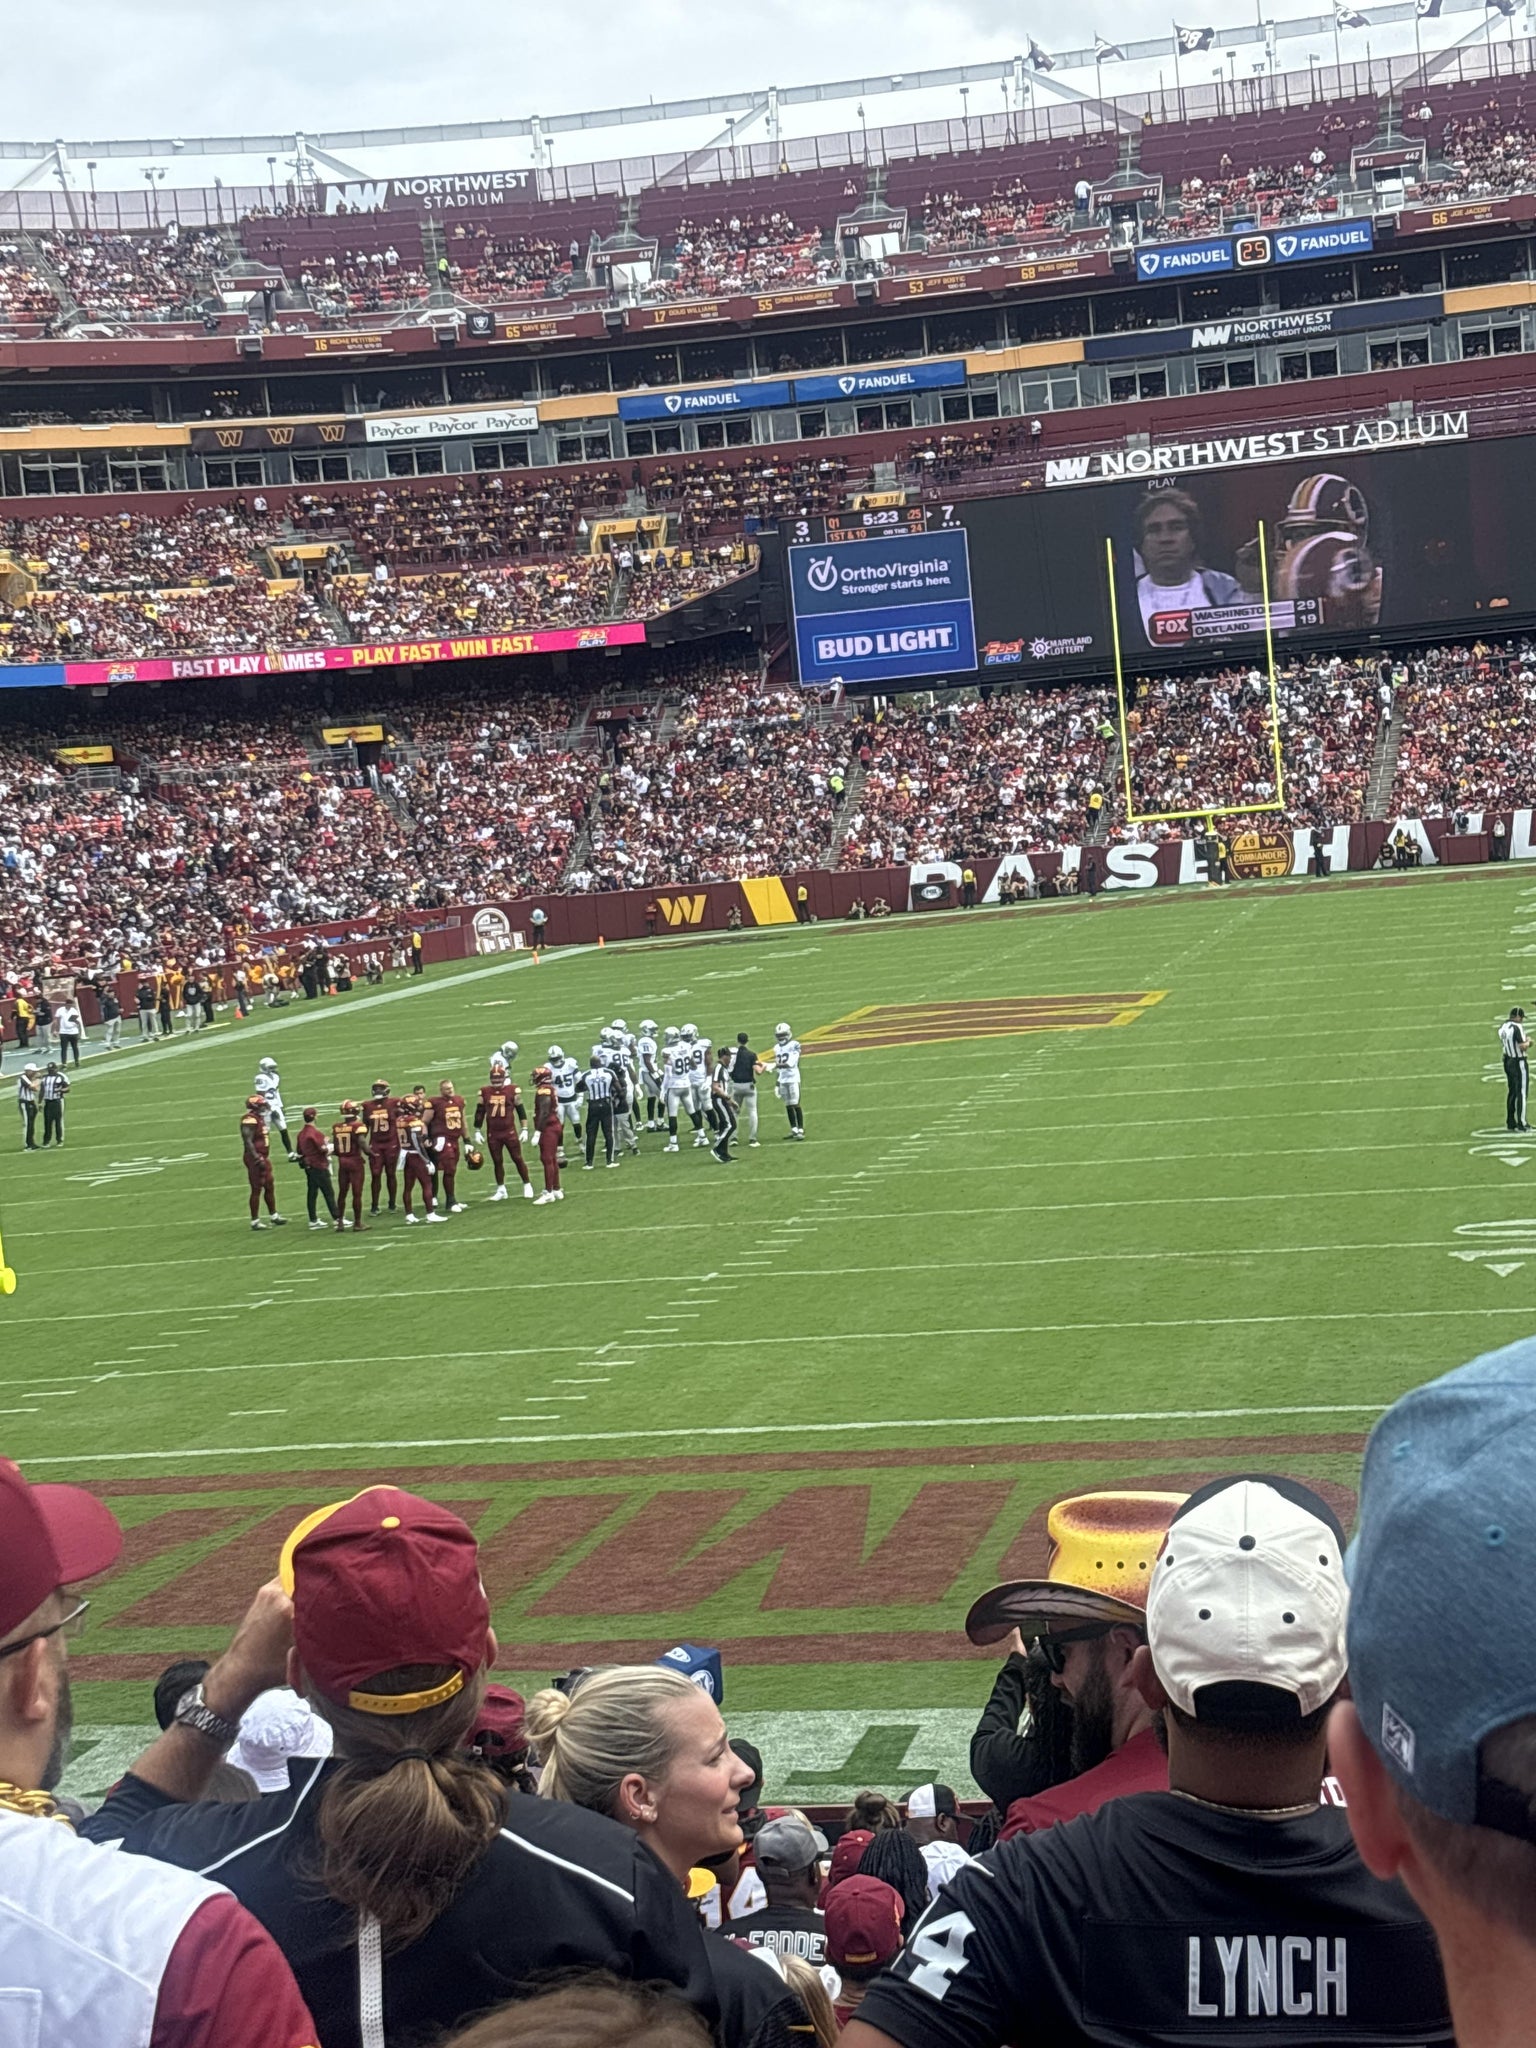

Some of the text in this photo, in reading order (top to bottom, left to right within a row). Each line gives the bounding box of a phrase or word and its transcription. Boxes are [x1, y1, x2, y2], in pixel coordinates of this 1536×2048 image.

[1359, 158, 1374, 167] 441
[1404, 152, 1420, 160] 442
[393, 172, 529, 196] NORTHWEST
[1097, 194, 1112, 203] 440
[1142, 188, 1158, 197] 441
[424, 191, 504, 210] STADIUM
[1432, 211, 1448, 225] 66
[845, 227, 859, 235] 439
[888, 221, 902, 230] 440
[1301, 230, 1369, 250] FANDUEL
[638, 250, 653, 259] 439
[1243, 240, 1265, 259] 25
[596, 255, 610, 264] 438
[1163, 249, 1230, 268] FANDUEL
[1021, 267, 1036, 280] 68
[221, 281, 235, 289] 436
[263, 280, 278, 288] 437
[909, 281, 924, 294] 53
[758, 299, 773, 312] 55
[654, 310, 666, 323] 17
[506, 325, 520, 338] 65
[1191, 311, 1333, 348] NW NORTHWEST
[1234, 324, 1332, 342] FEDERAL CREDIT UNION
[314, 339, 328, 351] 16
[859, 373, 915, 390] FANDUEL
[685, 392, 740, 408] FANDUEL
[371, 415, 535, 438] Paycor Paycor Paycor
[1045, 411, 1469, 482] NW NORTHWEST STADIUM
[1148, 476, 1177, 490] PLAY
[941, 505, 954, 520] 7
[828, 518, 840, 530] Q1
[862, 510, 899, 526] 5:23
[795, 521, 809, 536] 3
[829, 531, 845, 541] 1ST
[856, 529, 867, 539] 10
[910, 523, 923, 533] 24
[841, 558, 950, 581] OrthoVirginia
[841, 583, 888, 595] Stronger
[891, 579, 923, 590] starts
[1156, 600, 1316, 635] FOX WASHINGTO 29
[1194, 614, 1317, 636] OAKLAND 19
[579, 639, 606, 648] PLAY
[818, 627, 952, 659] BUD LIGHT
[1050, 635, 1093, 647] MARYLAND
[172, 659, 215, 678] FAST
[218, 656, 260, 674] PLAY
[352, 647, 395, 666] PLAY
[400, 643, 447, 661] FAST.
[450, 638, 489, 658] WIN
[492, 635, 539, 654] FAST.
[1050, 645, 1085, 656] LOTTERY
[987, 654, 1020, 663] PLAY
[109, 673, 135, 682] PLAY
[596, 710, 611, 719] 229
[1242, 839, 1256, 848] 19
[1233, 850, 1288, 863] COMMANDERS
[1265, 866, 1279, 876] 32
[554, 1074, 573, 1088] 45
[489, 1097, 506, 1117] 71
[369, 1113, 390, 1133] 75
[337, 1133, 352, 1153] 17
[1188, 1935, 1348, 2017] LYNCH
